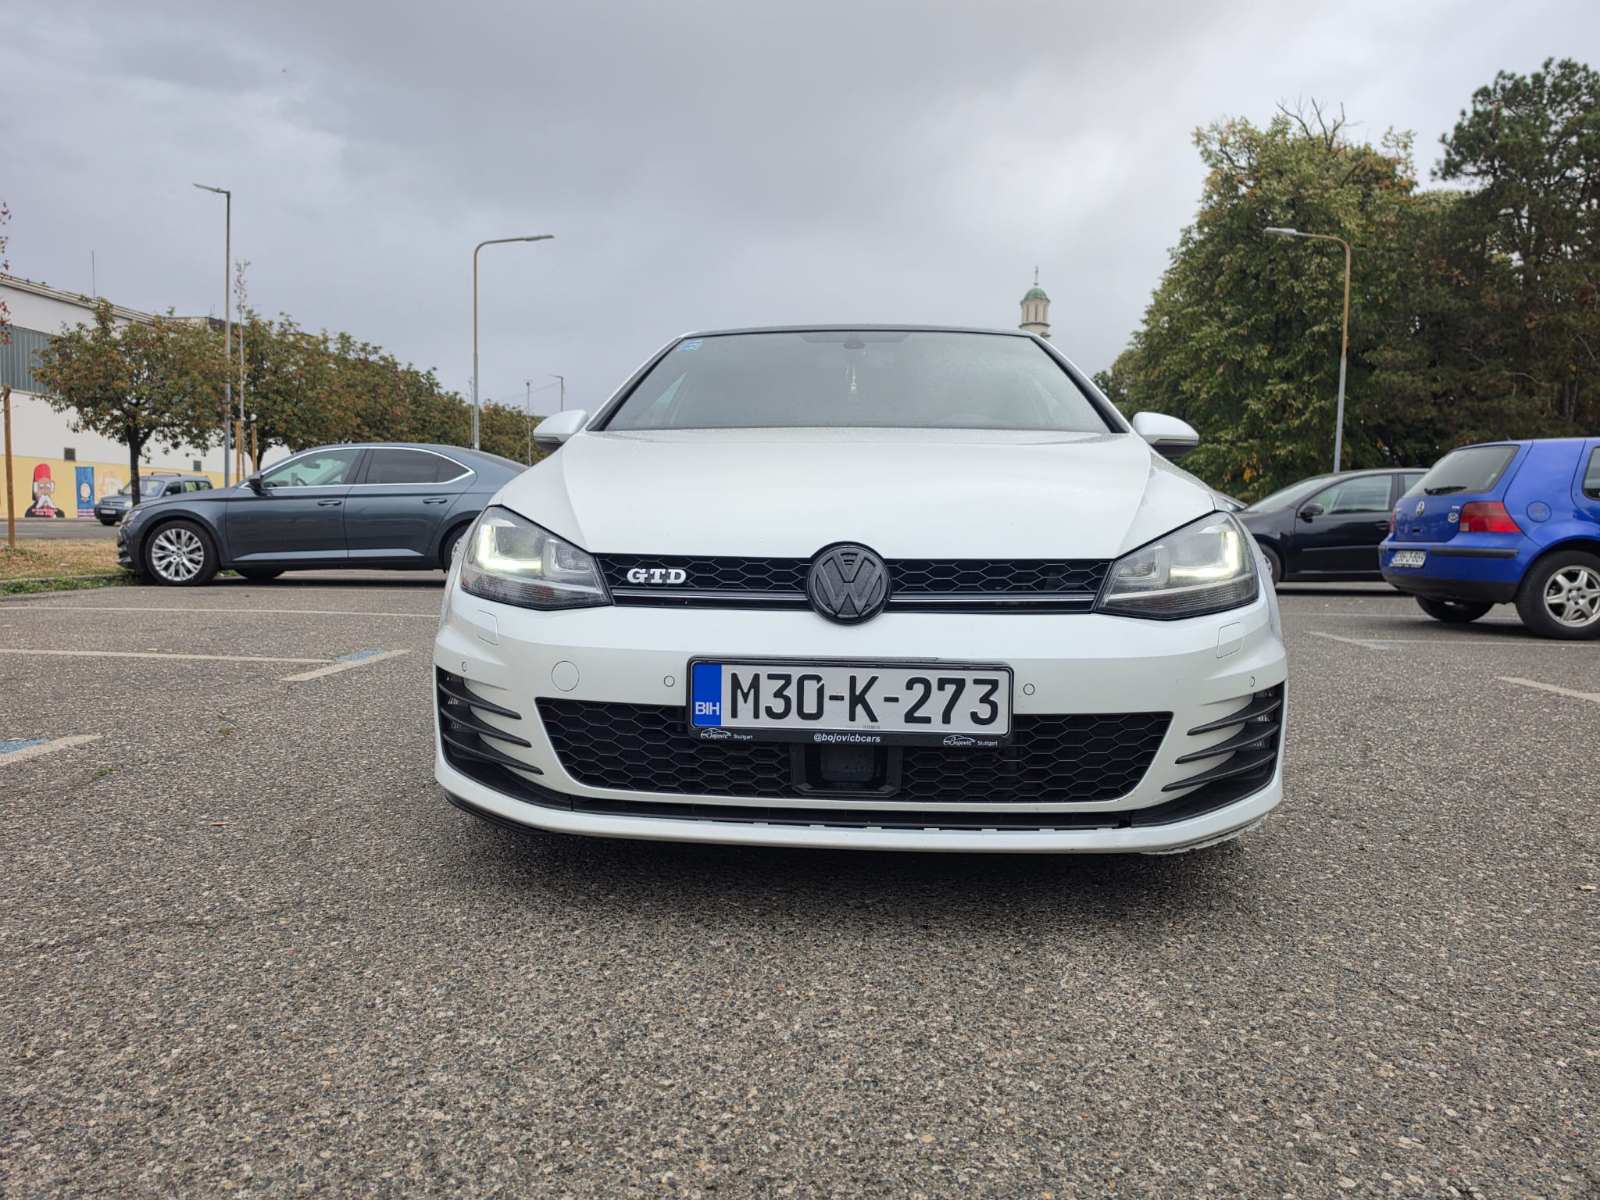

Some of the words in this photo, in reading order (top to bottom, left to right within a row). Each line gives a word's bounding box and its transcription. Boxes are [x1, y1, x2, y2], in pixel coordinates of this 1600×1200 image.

[626, 568, 687, 584] GTD
[731, 672, 999, 725] M30-K-273
[695, 702, 720, 715] BIH
[813, 732, 881, 743] @bojovicbcars
